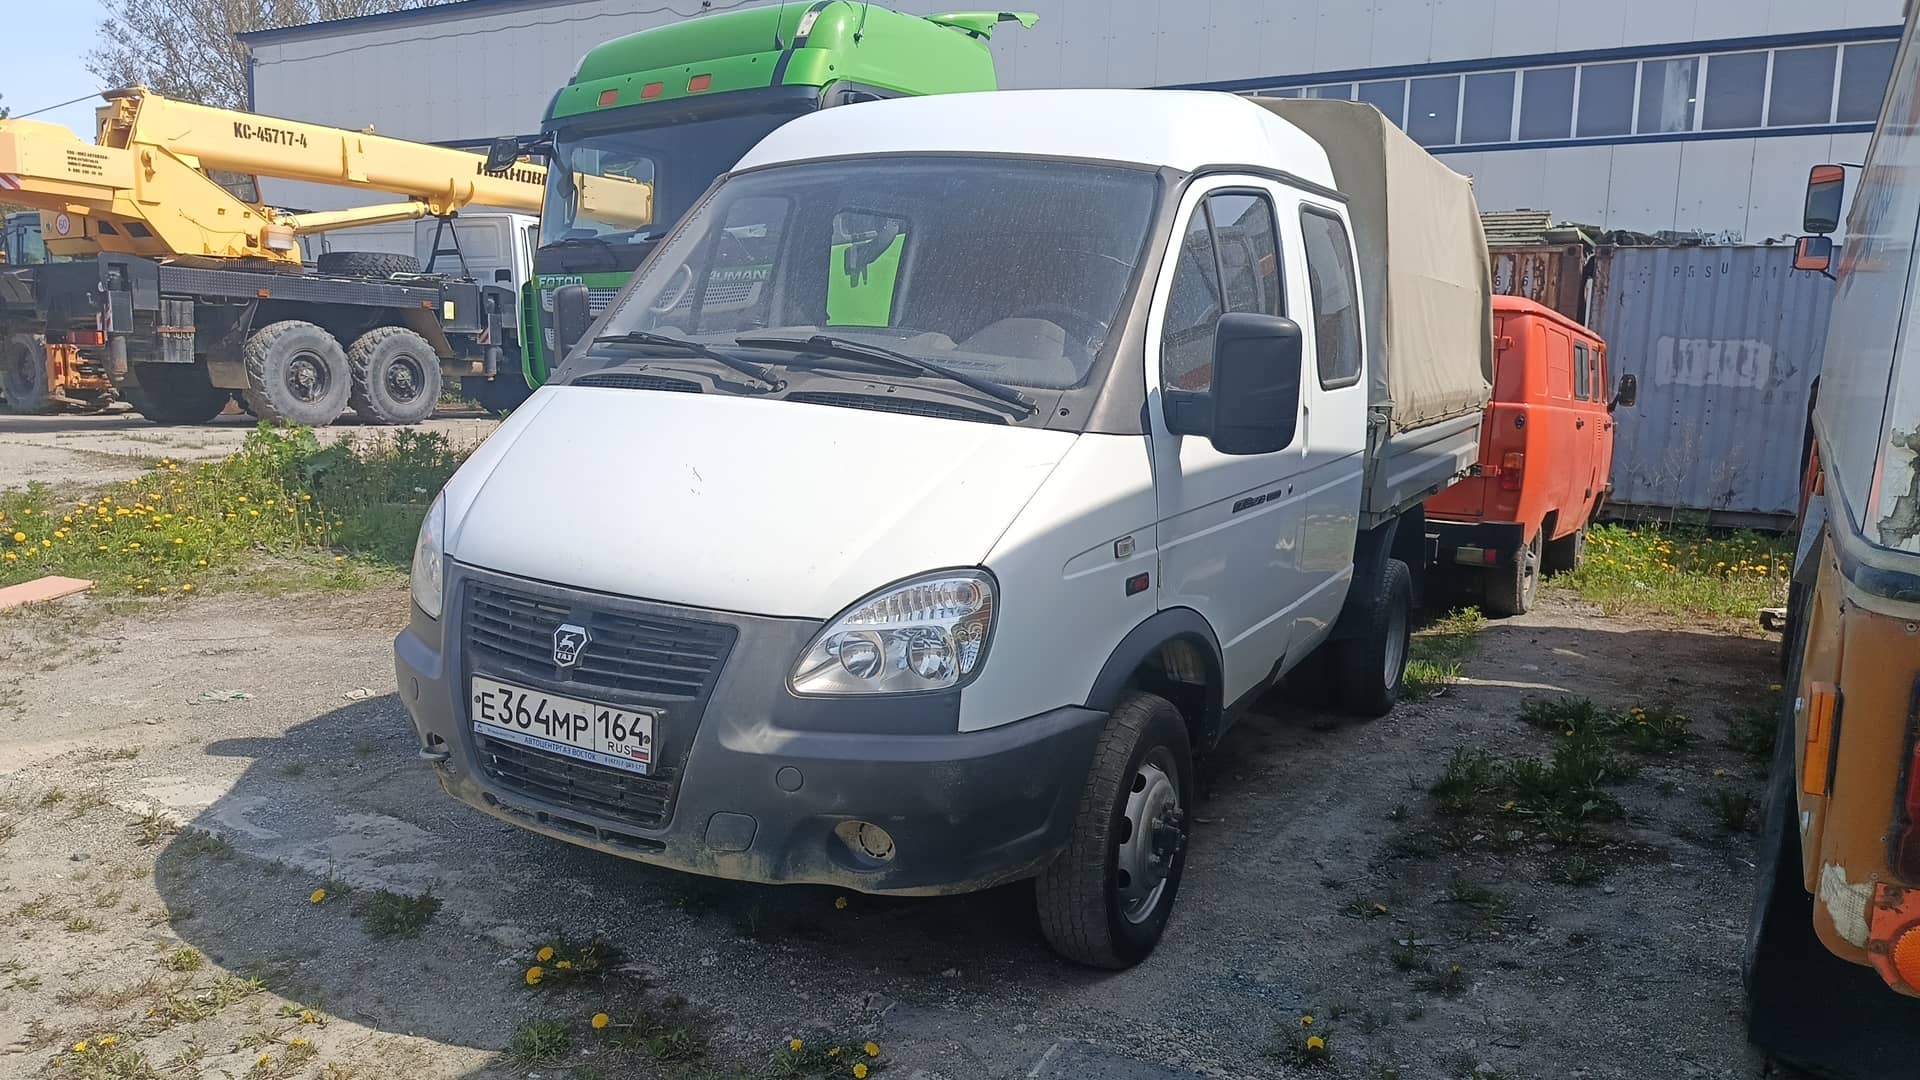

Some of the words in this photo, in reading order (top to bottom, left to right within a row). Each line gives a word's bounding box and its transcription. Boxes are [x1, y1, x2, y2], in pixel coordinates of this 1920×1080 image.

[233, 121, 308, 149] КС-45717-4
[597, 710, 644, 746] 164
[607, 741, 631, 755] RUS
